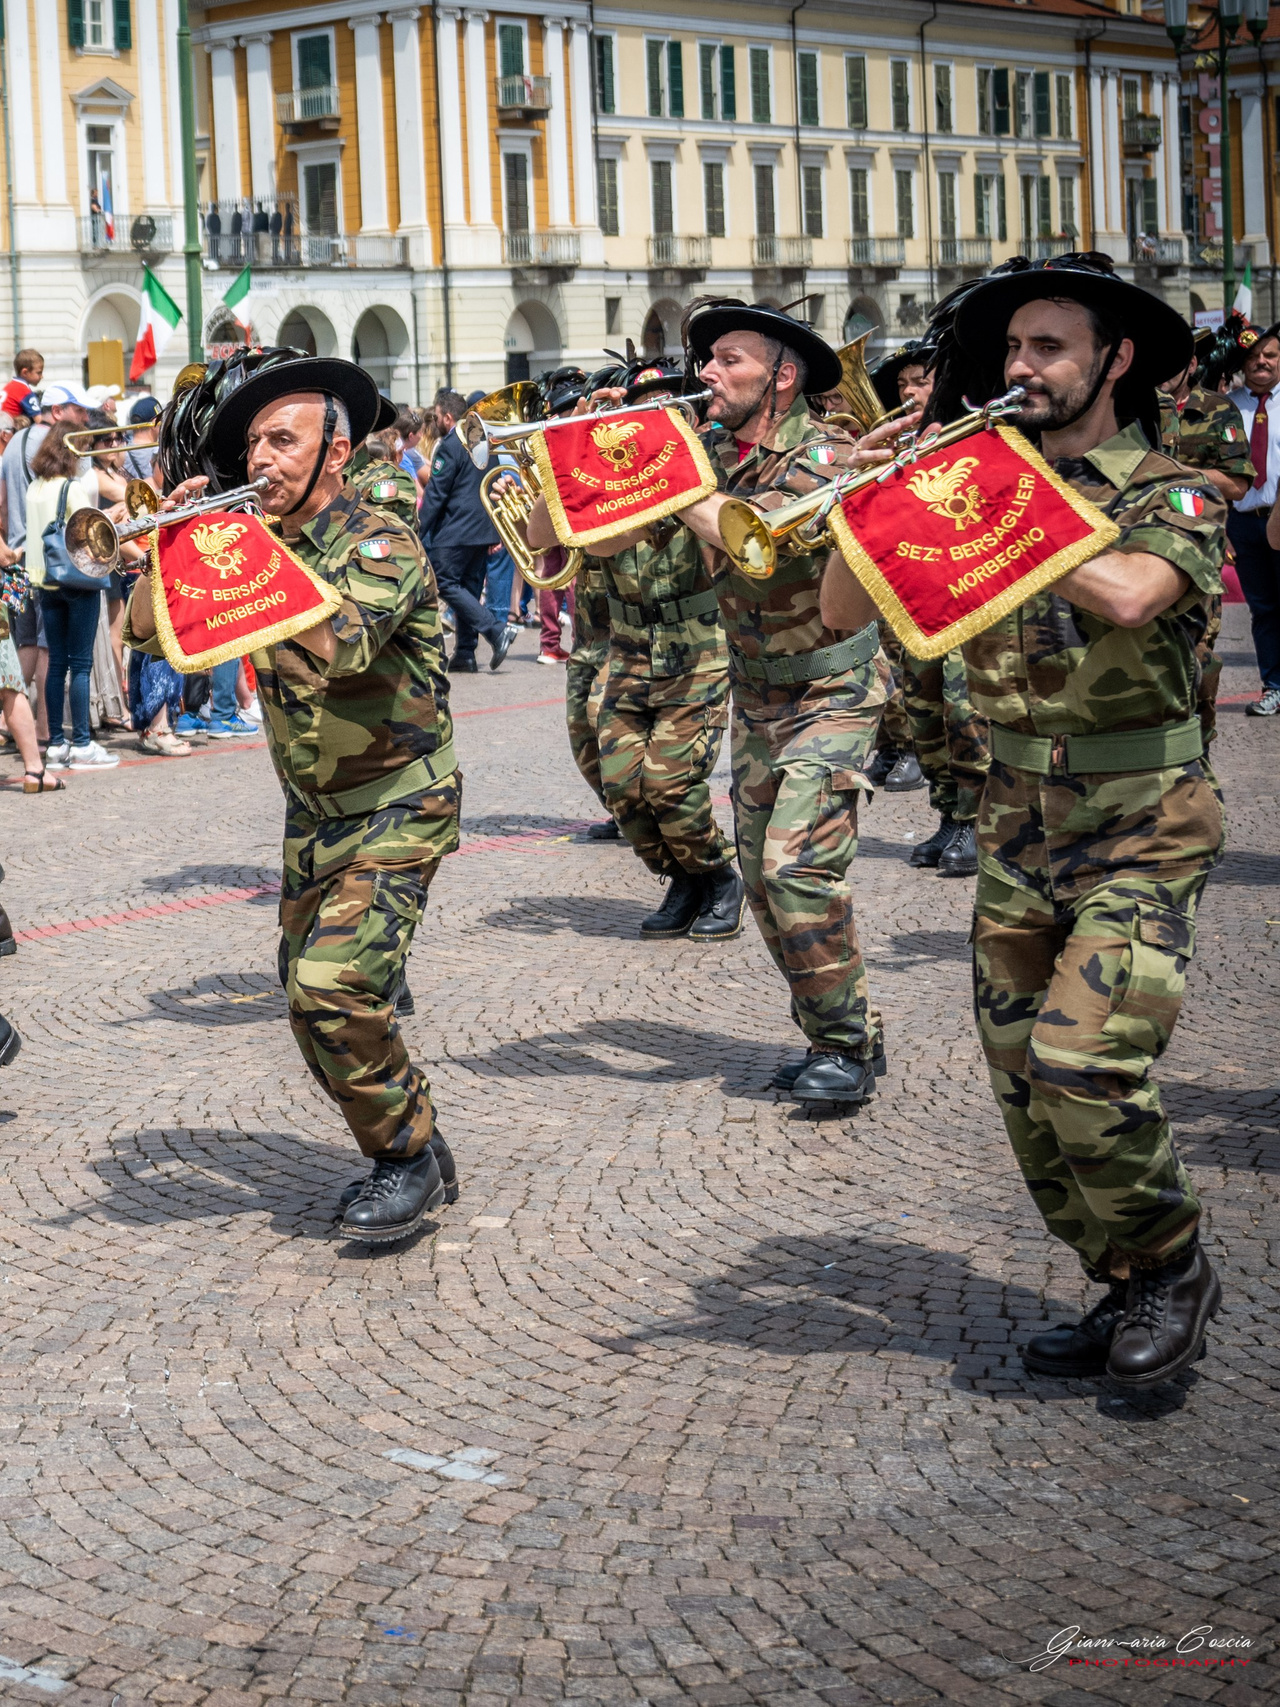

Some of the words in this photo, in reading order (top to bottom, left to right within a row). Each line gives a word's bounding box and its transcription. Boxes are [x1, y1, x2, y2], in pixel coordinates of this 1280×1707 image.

[28, 397, 41, 411] 3
[605, 440, 678, 491] BERSAGLIERI
[595, 478, 669, 515] MORBEGNO
[949, 473, 1036, 561] BERSAGLIERI
[212, 549, 281, 601] BERSAGLIERI
[947, 527, 1045, 599] MORBEGNO
[205, 590, 287, 630] MORBEGNO
